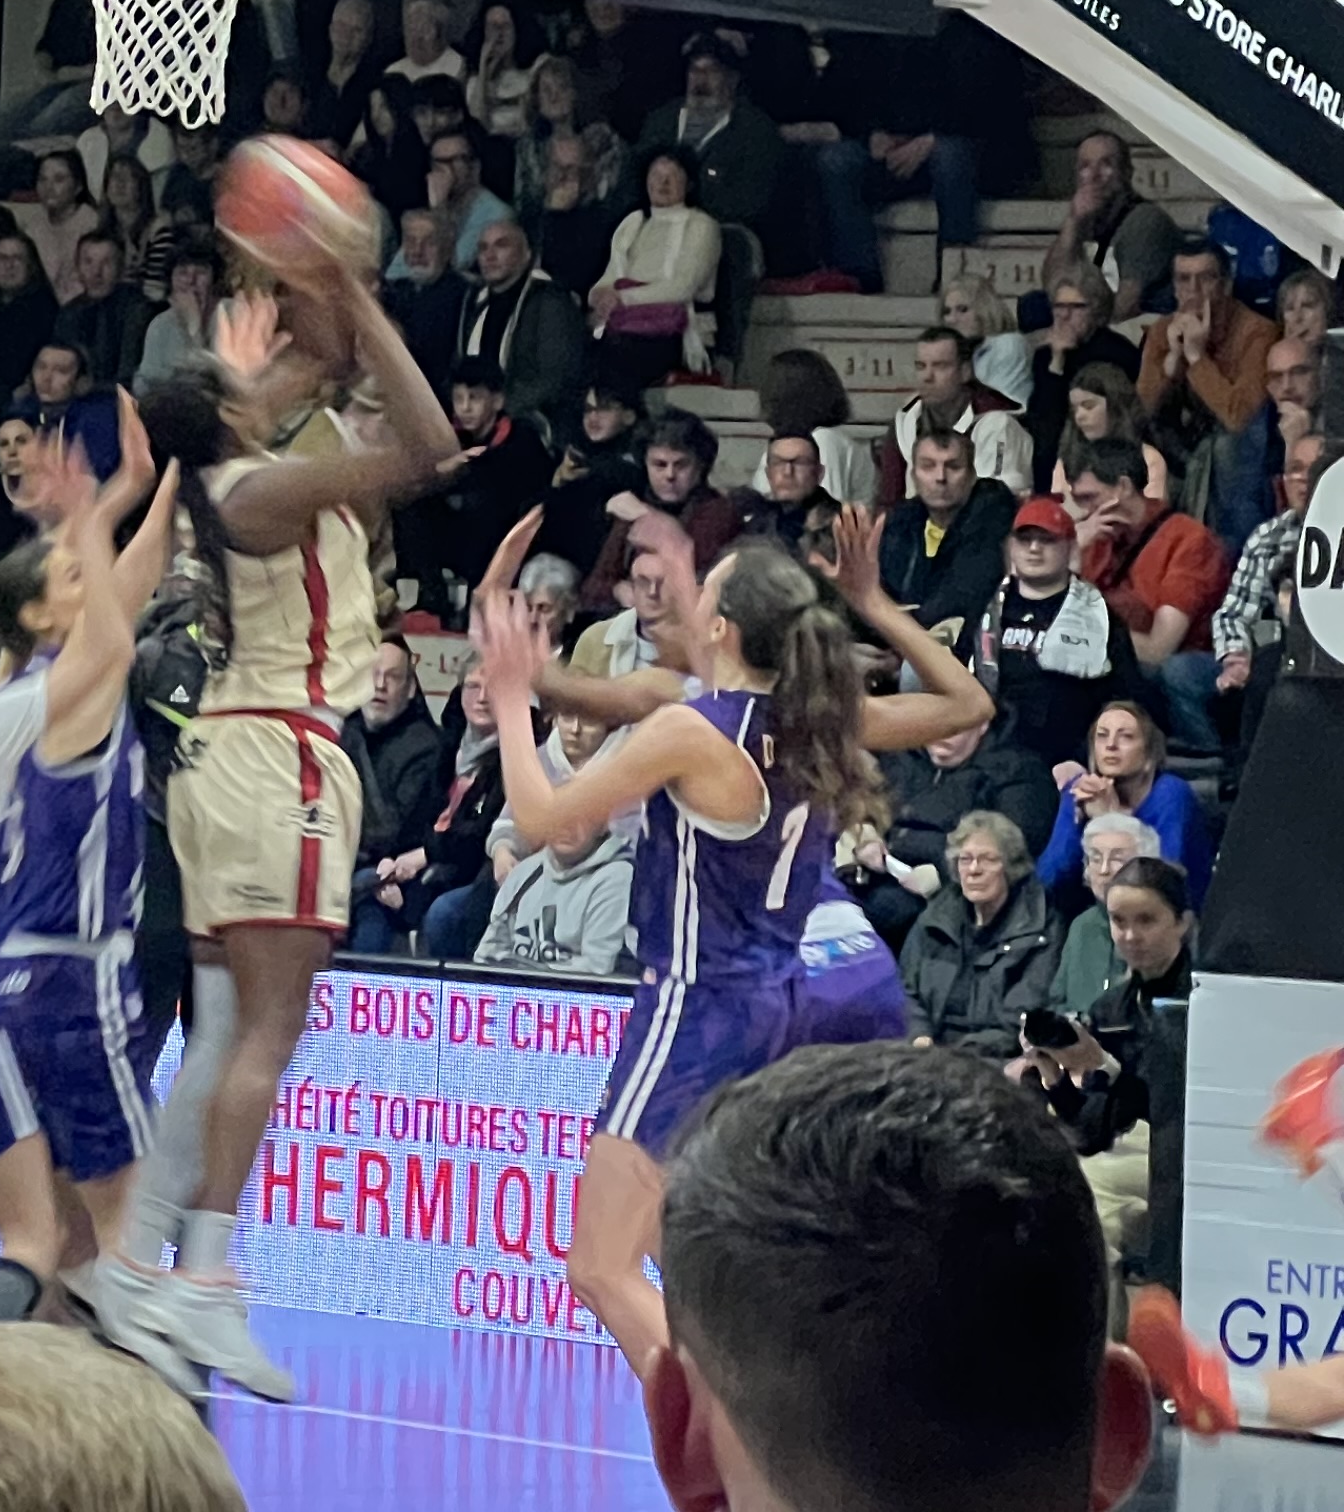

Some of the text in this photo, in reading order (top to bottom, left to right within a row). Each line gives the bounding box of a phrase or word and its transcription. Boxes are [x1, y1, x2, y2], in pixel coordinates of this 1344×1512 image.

[1266, 46, 1344, 129] CHARL
[349, 982, 435, 1041] BOIS
[449, 990, 498, 1048] DE
[369, 1091, 529, 1156] TOITURES
[261, 1140, 582, 1264] HERMIQU
